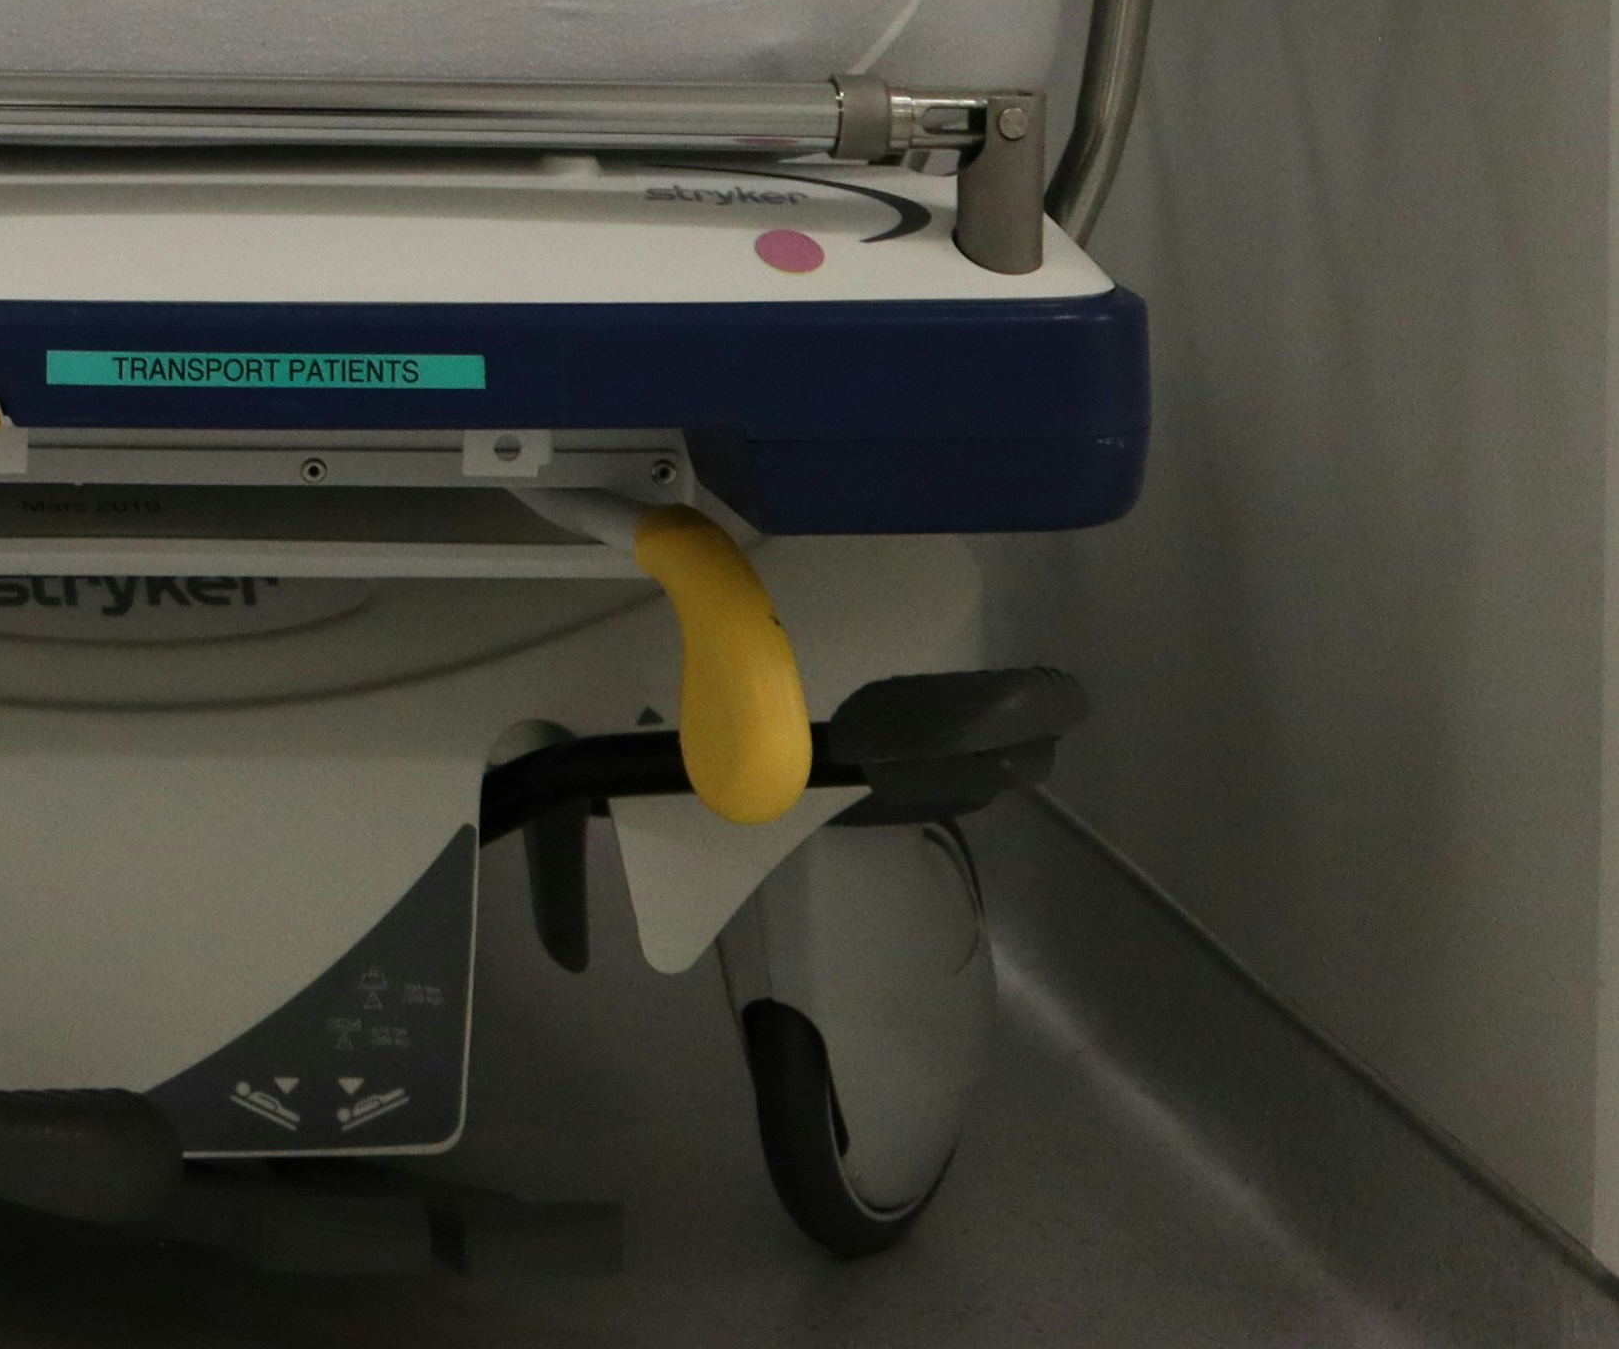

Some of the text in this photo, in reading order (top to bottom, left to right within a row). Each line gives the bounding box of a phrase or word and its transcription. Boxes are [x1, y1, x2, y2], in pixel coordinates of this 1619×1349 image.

[644, 184, 809, 207] stryker
[113, 356, 420, 384] TRANSPORT PATIENTS
